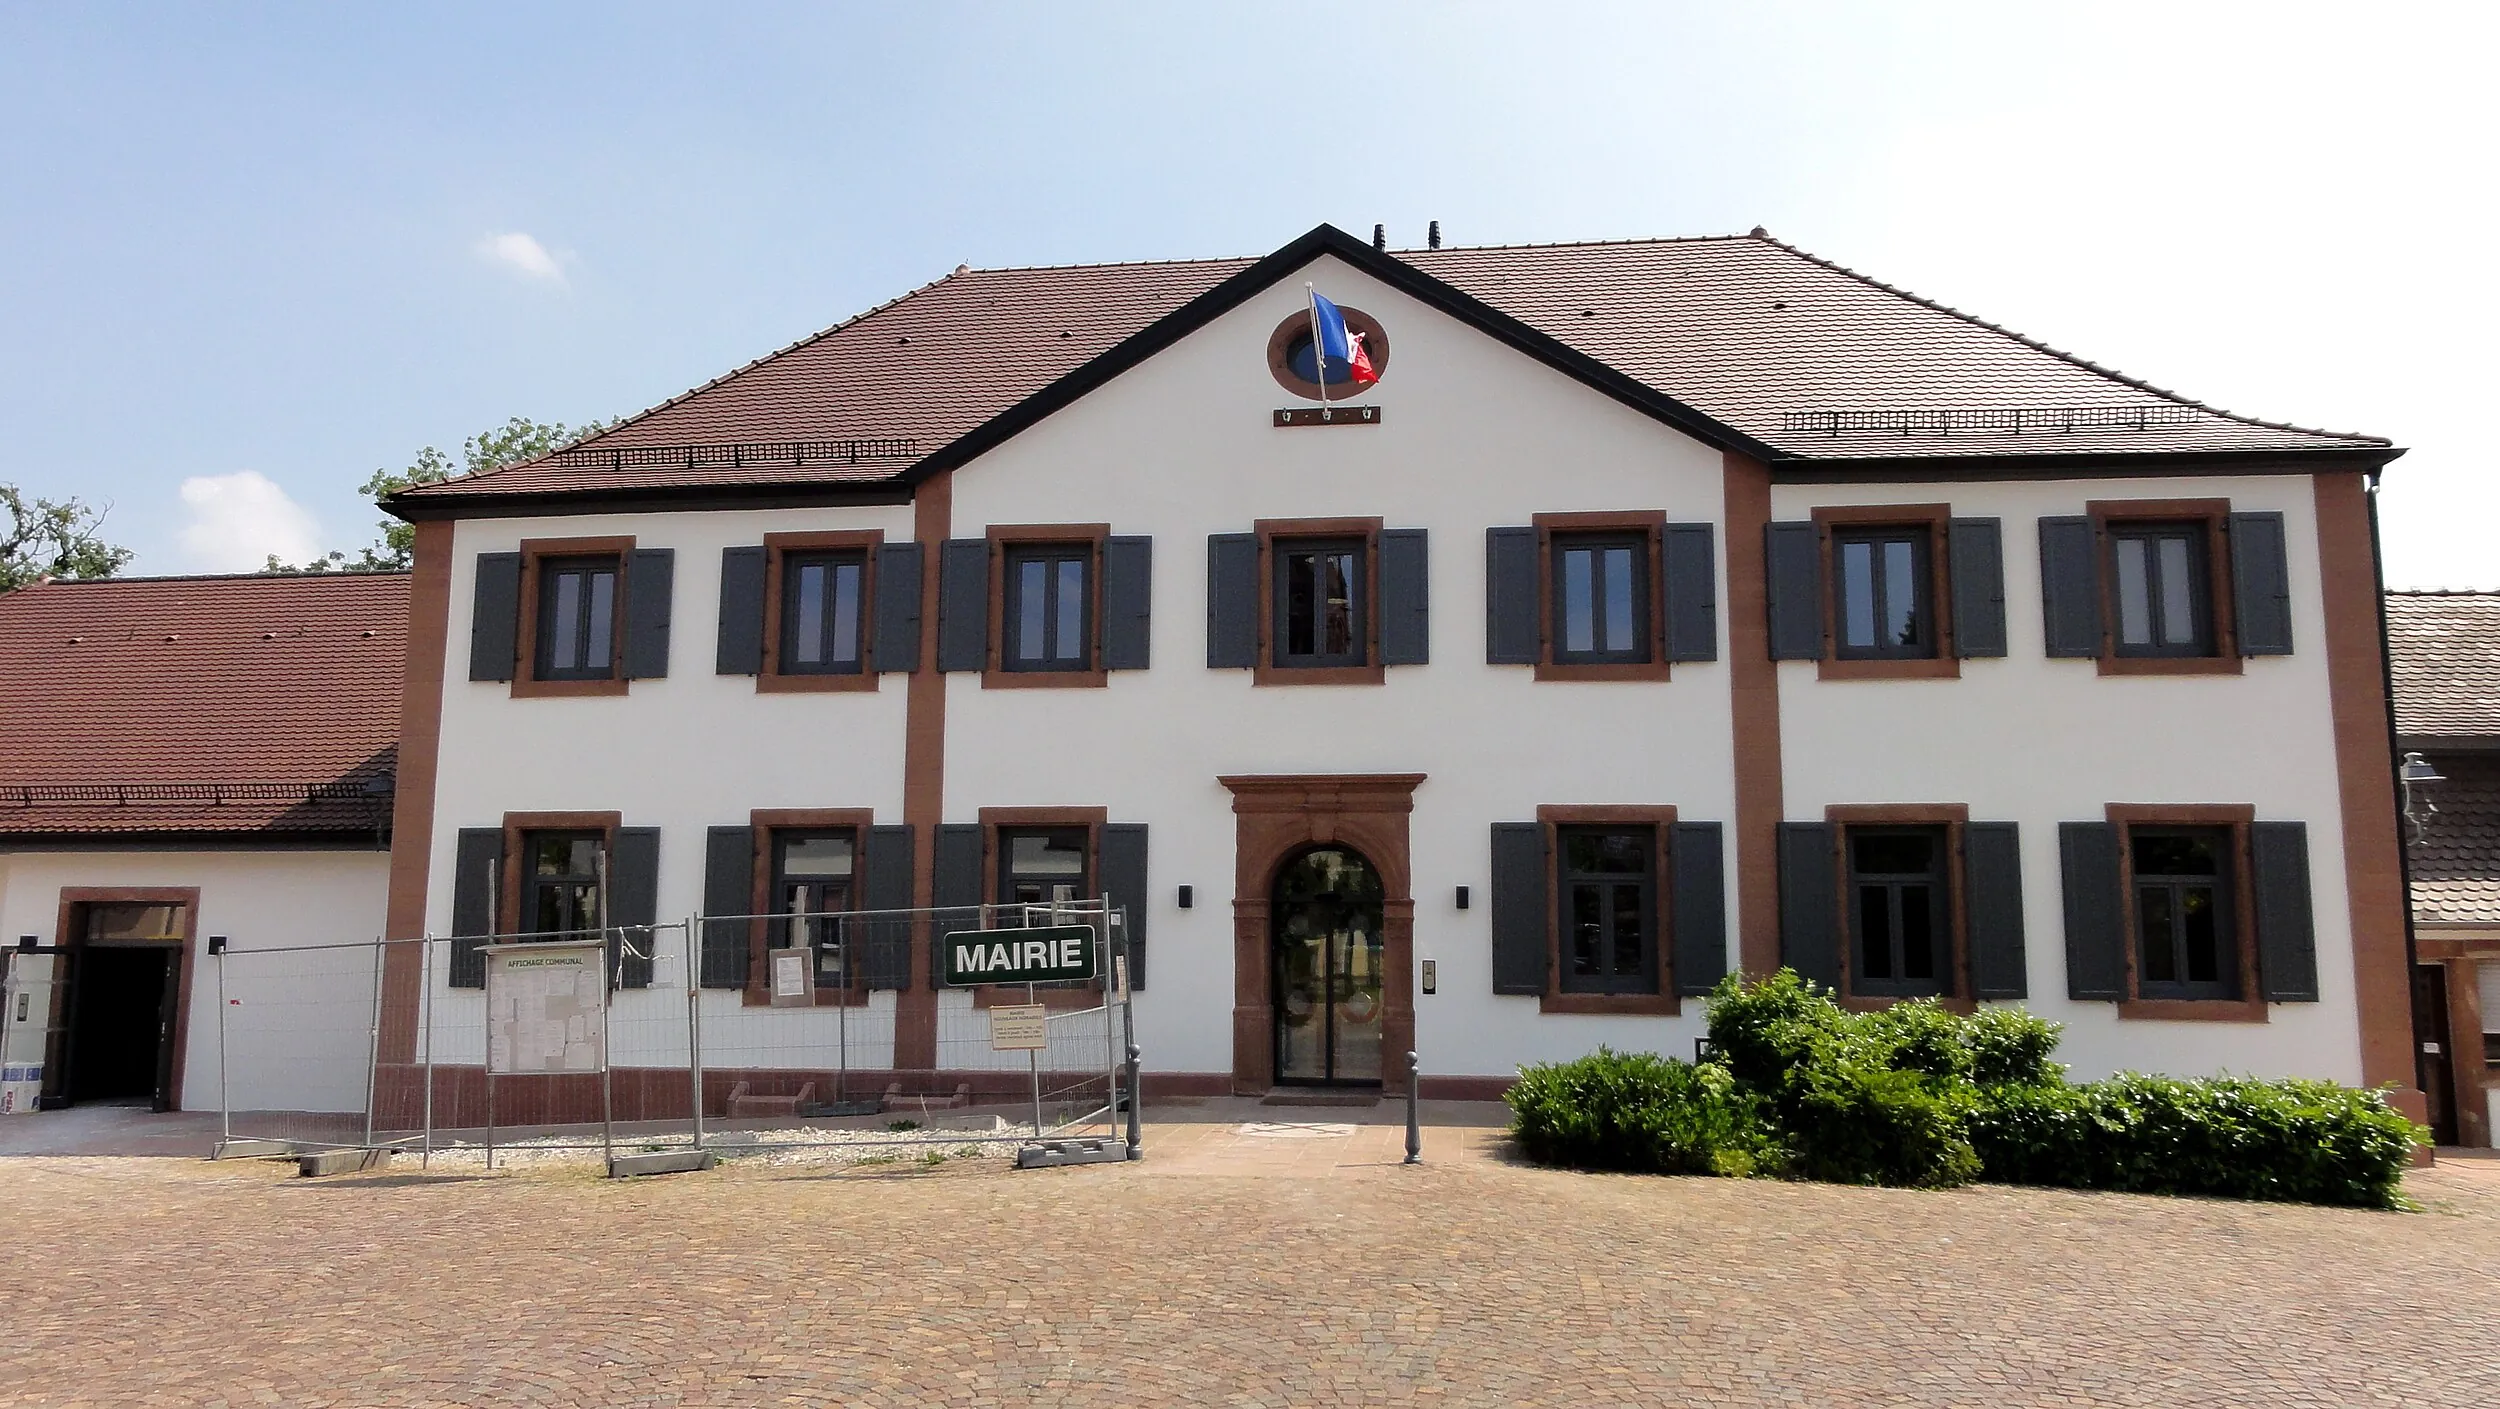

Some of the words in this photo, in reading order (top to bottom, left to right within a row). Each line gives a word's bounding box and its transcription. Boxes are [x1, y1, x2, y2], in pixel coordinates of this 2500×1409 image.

[507, 958, 544, 968] AFFICHAGE
[545, 957, 584, 966] COMMUNAL
[956, 939, 1083, 973] MAIRIE
